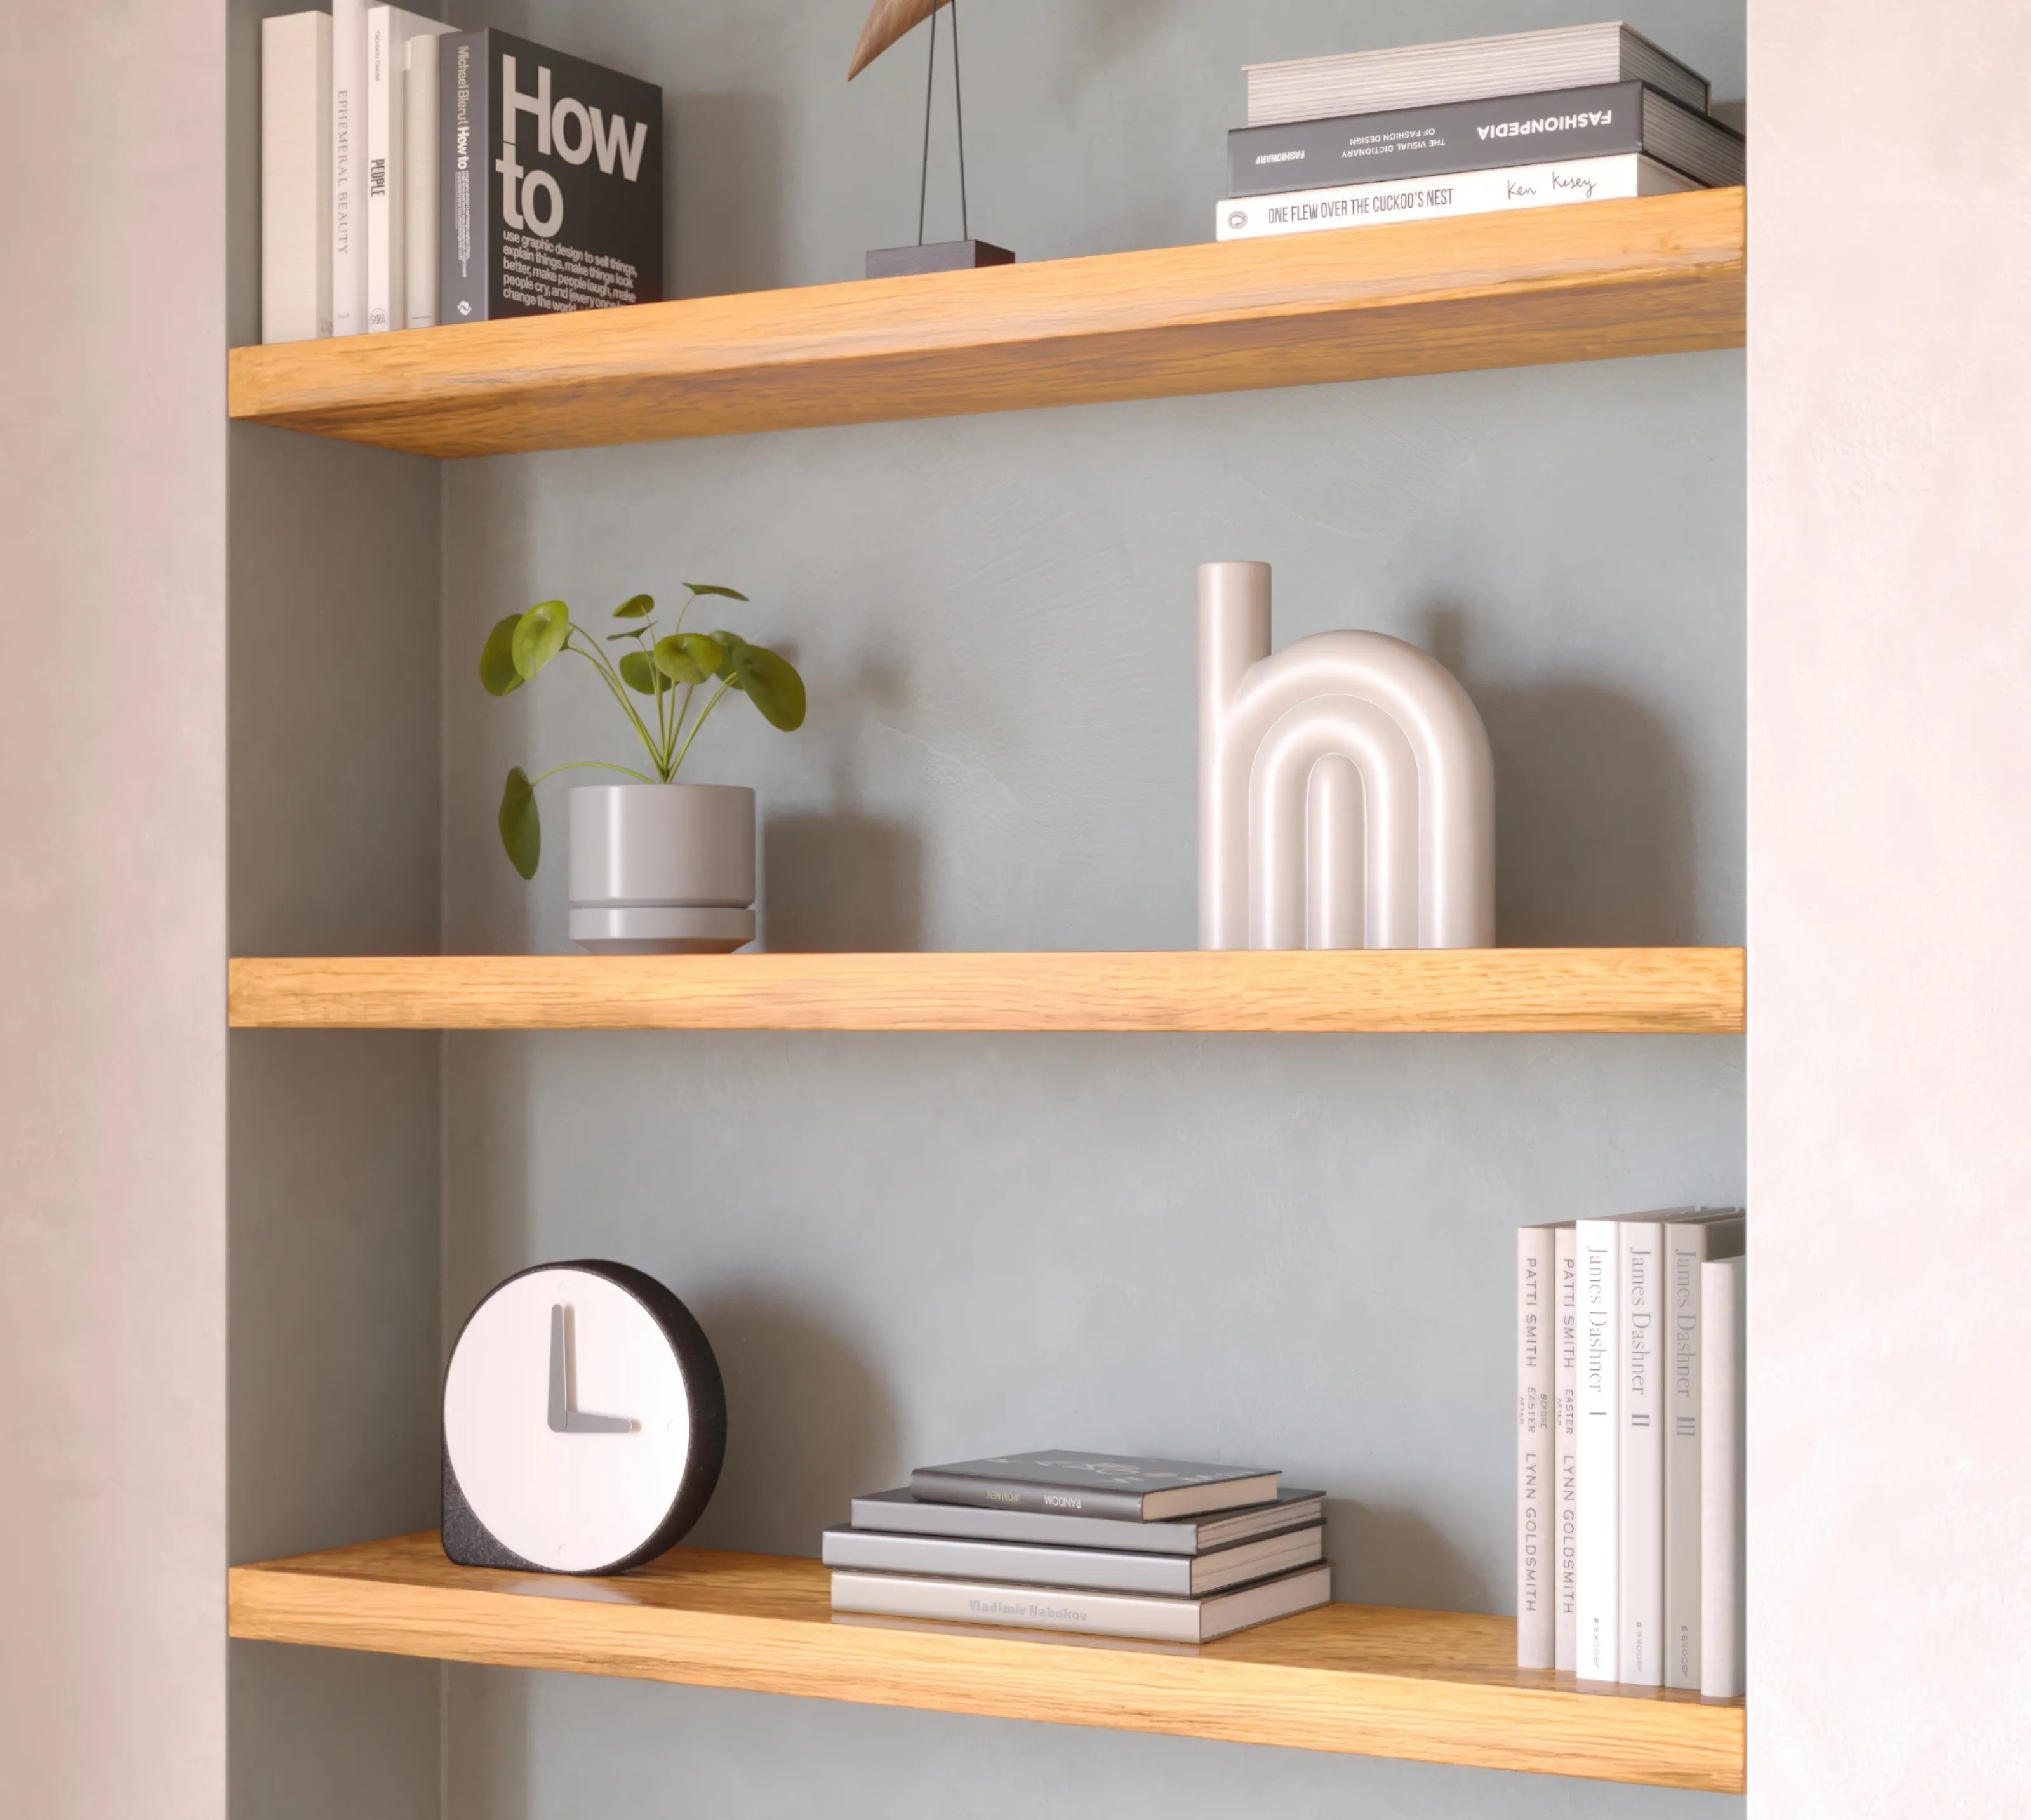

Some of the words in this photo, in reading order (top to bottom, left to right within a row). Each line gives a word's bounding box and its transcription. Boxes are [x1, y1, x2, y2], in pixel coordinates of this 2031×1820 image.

[457, 46, 470, 89] Michael
[457, 90, 470, 125] Bierut
[502, 53, 648, 182] How
[1476, 109, 1613, 141] FASHIONPEDIA
[337, 90, 348, 187] EPHEMERAL
[457, 126, 470, 154] How
[1342, 145, 1394, 158] DICTIONARY
[1349, 134, 1381, 146] DESIGN
[1382, 130, 1422, 141] FASHION
[1396, 140, 1427, 151] VISUAL
[1423, 128, 1436, 136] OF
[1428, 138, 1446, 147] THE
[371, 158, 385, 198] PEOPLE
[457, 155, 470, 170] to
[1255, 150, 1305, 164] FASHIONARY
[495, 142, 564, 238] to
[1269, 206, 1288, 224] ONE
[1291, 203, 1319, 222] FLEW
[1321, 200, 1348, 218] OVER
[1350, 197, 1371, 215] THE
[1373, 191, 1424, 213] CUCKOO'S
[1427, 188, 1455, 207] NEST
[1507, 179, 1537, 200] Ken
[1552, 171, 1597, 199] Kesey
[337, 192, 348, 255] BEAUTY
[503, 230, 521, 244] use
[521, 236, 554, 253] graphic
[555, 242, 583, 263] design
[584, 250, 594, 264] to
[594, 255, 609, 268] sell
[503, 245, 535, 262] explain
[535, 251, 564, 272] things,
[564, 262, 589, 277] make
[589, 265, 615, 286] things
[615, 272, 634, 289] look
[503, 256, 532, 277] better,
[532, 267, 557, 282] make
[557, 274, 587, 290] people
[612, 288, 636, 303] make
[503, 274, 534, 291] people
[534, 281, 551, 296] cry,
[550, 286, 568, 299] and
[503, 286, 536, 306] change
[536, 294, 552, 309] the
[1526, 1258, 1537, 1306] PATTI
[1563, 1259, 1575, 1307] PATTI
[1587, 1245, 1608, 1304] James
[1630, 1246, 1651, 1307] James
[1675, 1248, 1696, 1308] James
[1526, 1314, 1537, 1368] SMITH
[1563, 1315, 1575, 1369] SMITH
[1588, 1311, 1608, 1393] Dashner
[1631, 1312, 1651, 1396] Dashner
[1676, 1314, 1696, 1398] Dashner
[1528, 1386, 1536, 1433] EASTER
[1565, 1389, 1574, 1435] EASTER
[1631, 1414, 1650, 1428] II
[1676, 1416, 1696, 1437] III
[1526, 1453, 1537, 1500] LYNN
[1563, 1455, 1575, 1501] LYNN
[1044, 1494, 1082, 1510] RANDOM
[1526, 1507, 1537, 1612] GOLDSMITH
[1563, 1509, 1575, 1614] GOLDSMITH
[968, 1598, 1027, 1617] Vladimir
[1029, 1602, 1088, 1621] Nabokov
